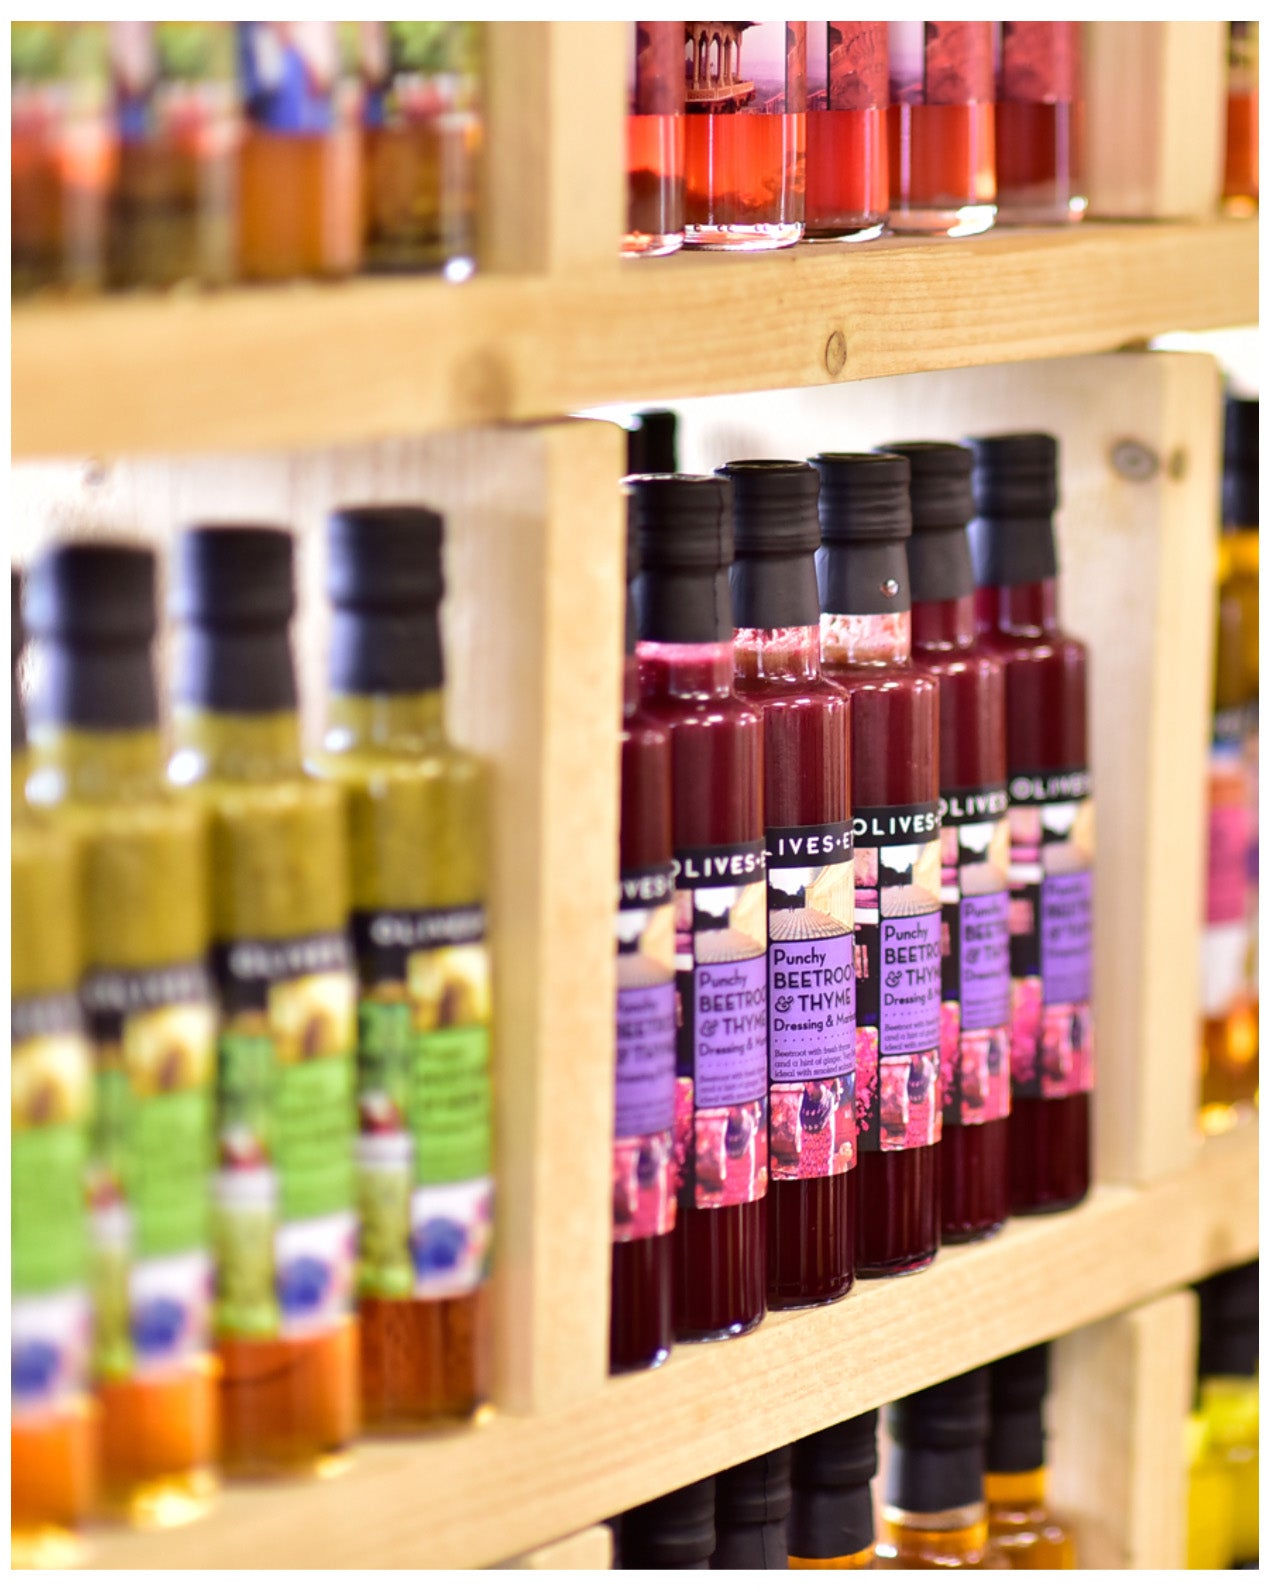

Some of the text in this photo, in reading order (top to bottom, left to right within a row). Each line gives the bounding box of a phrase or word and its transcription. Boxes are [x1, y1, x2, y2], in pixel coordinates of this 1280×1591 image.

[885, 922, 928, 942] Punchy
[774, 946, 826, 968] Punchy
[700, 968, 748, 989] Punchy
[775, 987, 851, 1013] & THYME
[774, 1018, 824, 1033] Dressing
[825, 1014, 834, 1028] &
